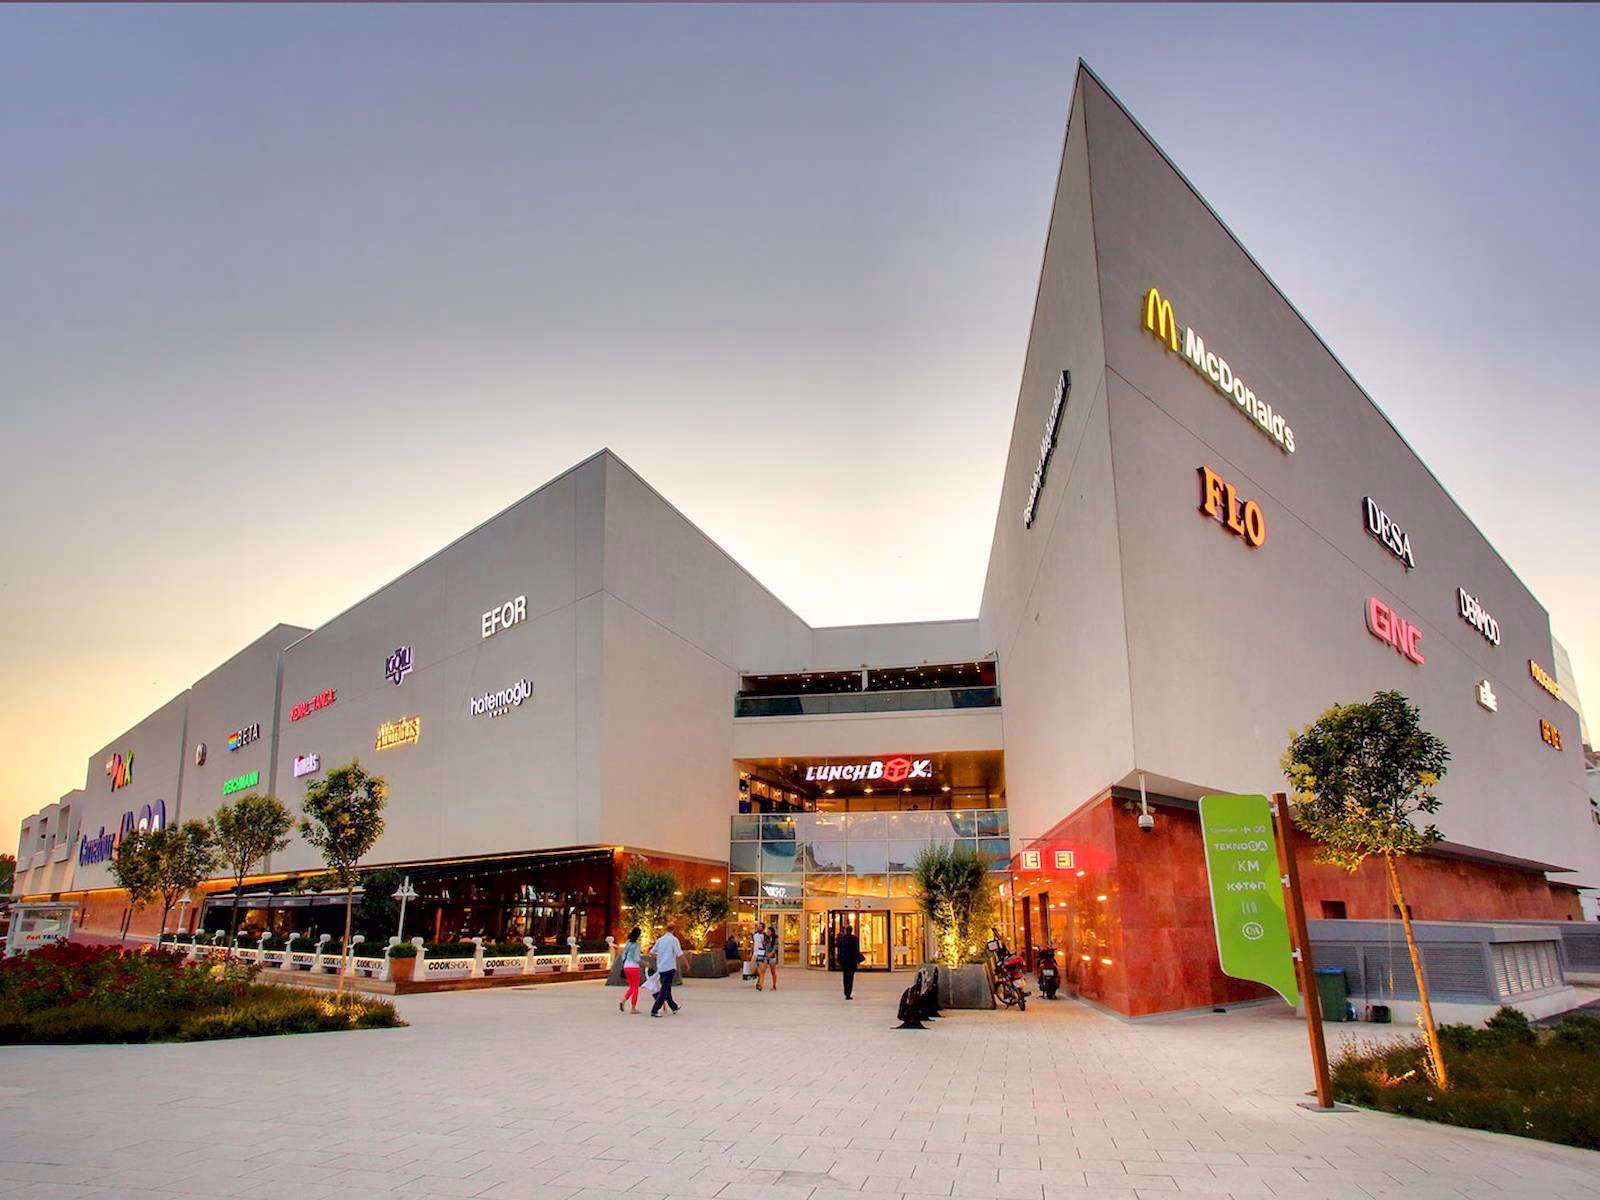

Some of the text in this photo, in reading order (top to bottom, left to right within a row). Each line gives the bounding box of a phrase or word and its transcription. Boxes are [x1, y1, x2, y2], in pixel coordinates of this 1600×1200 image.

[1186, 327, 1295, 453] McDonald's
[1202, 465, 1265, 547] FLO
[1366, 496, 1416, 569] DESA
[481, 595, 528, 639] EFOR
[1370, 597, 1425, 665] GNC
[470, 678, 533, 716] hatemoğlu
[238, 723, 260, 747] BETA
